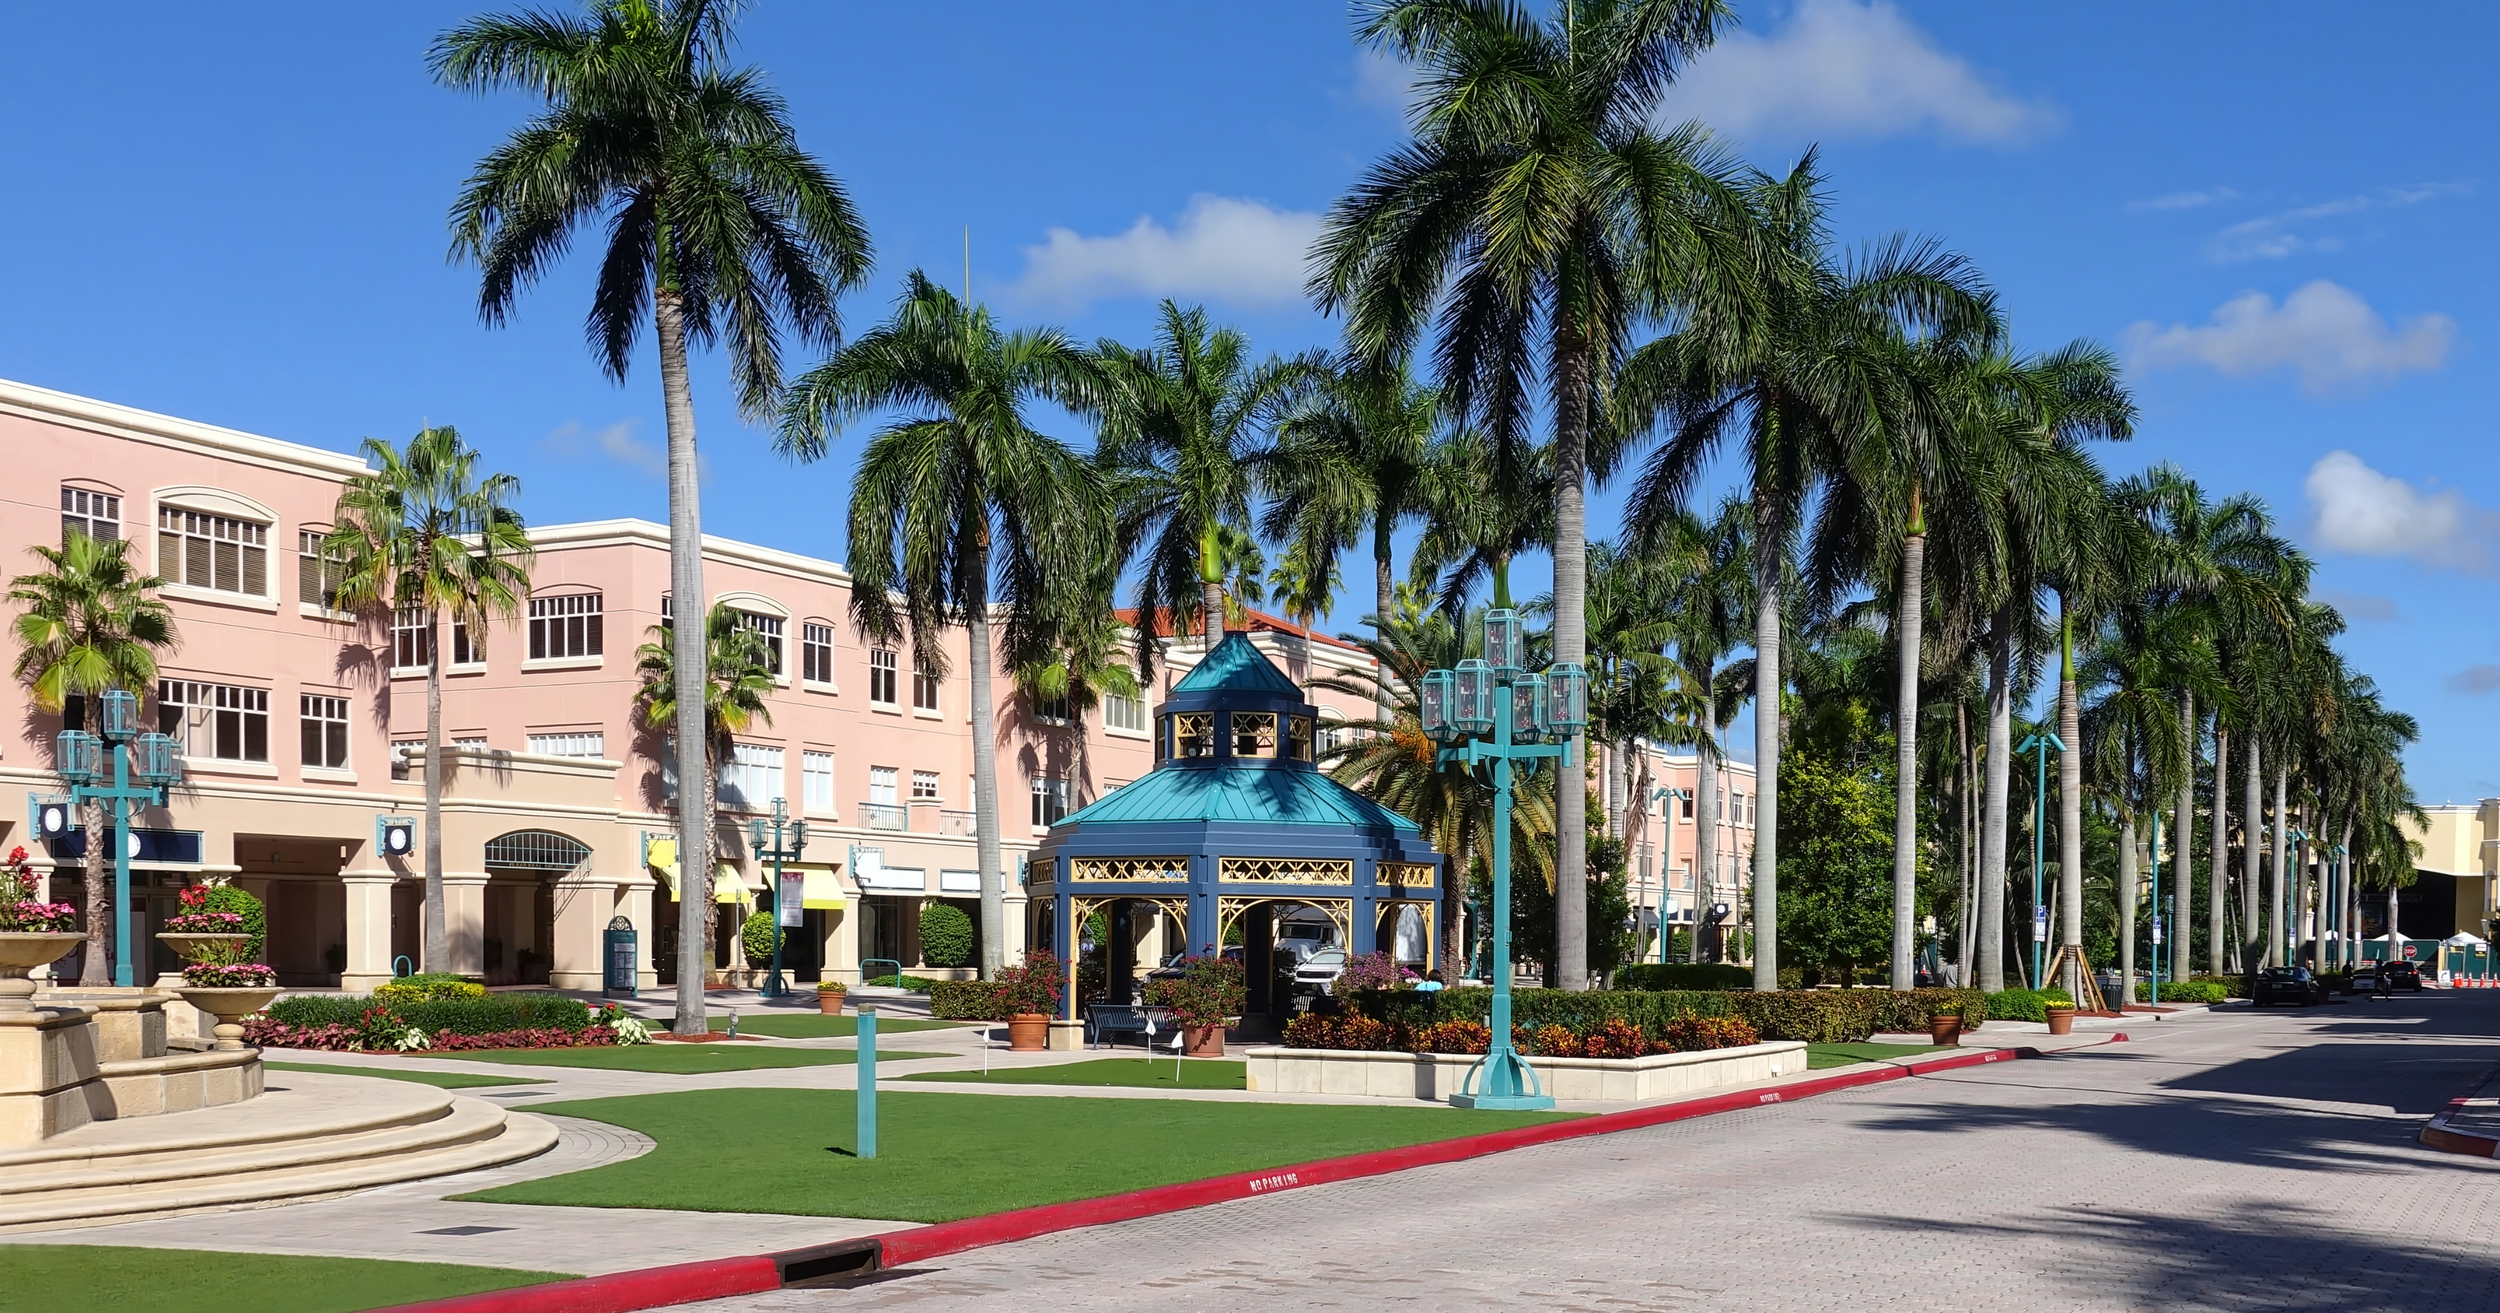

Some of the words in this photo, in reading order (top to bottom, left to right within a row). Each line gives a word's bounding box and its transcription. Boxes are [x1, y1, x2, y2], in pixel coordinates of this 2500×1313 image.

[2037, 906, 2044, 917] P
[2154, 916, 2160, 925] P
[1249, 1179, 1262, 1192] NO
[1262, 1173, 1298, 1190] PARKING
